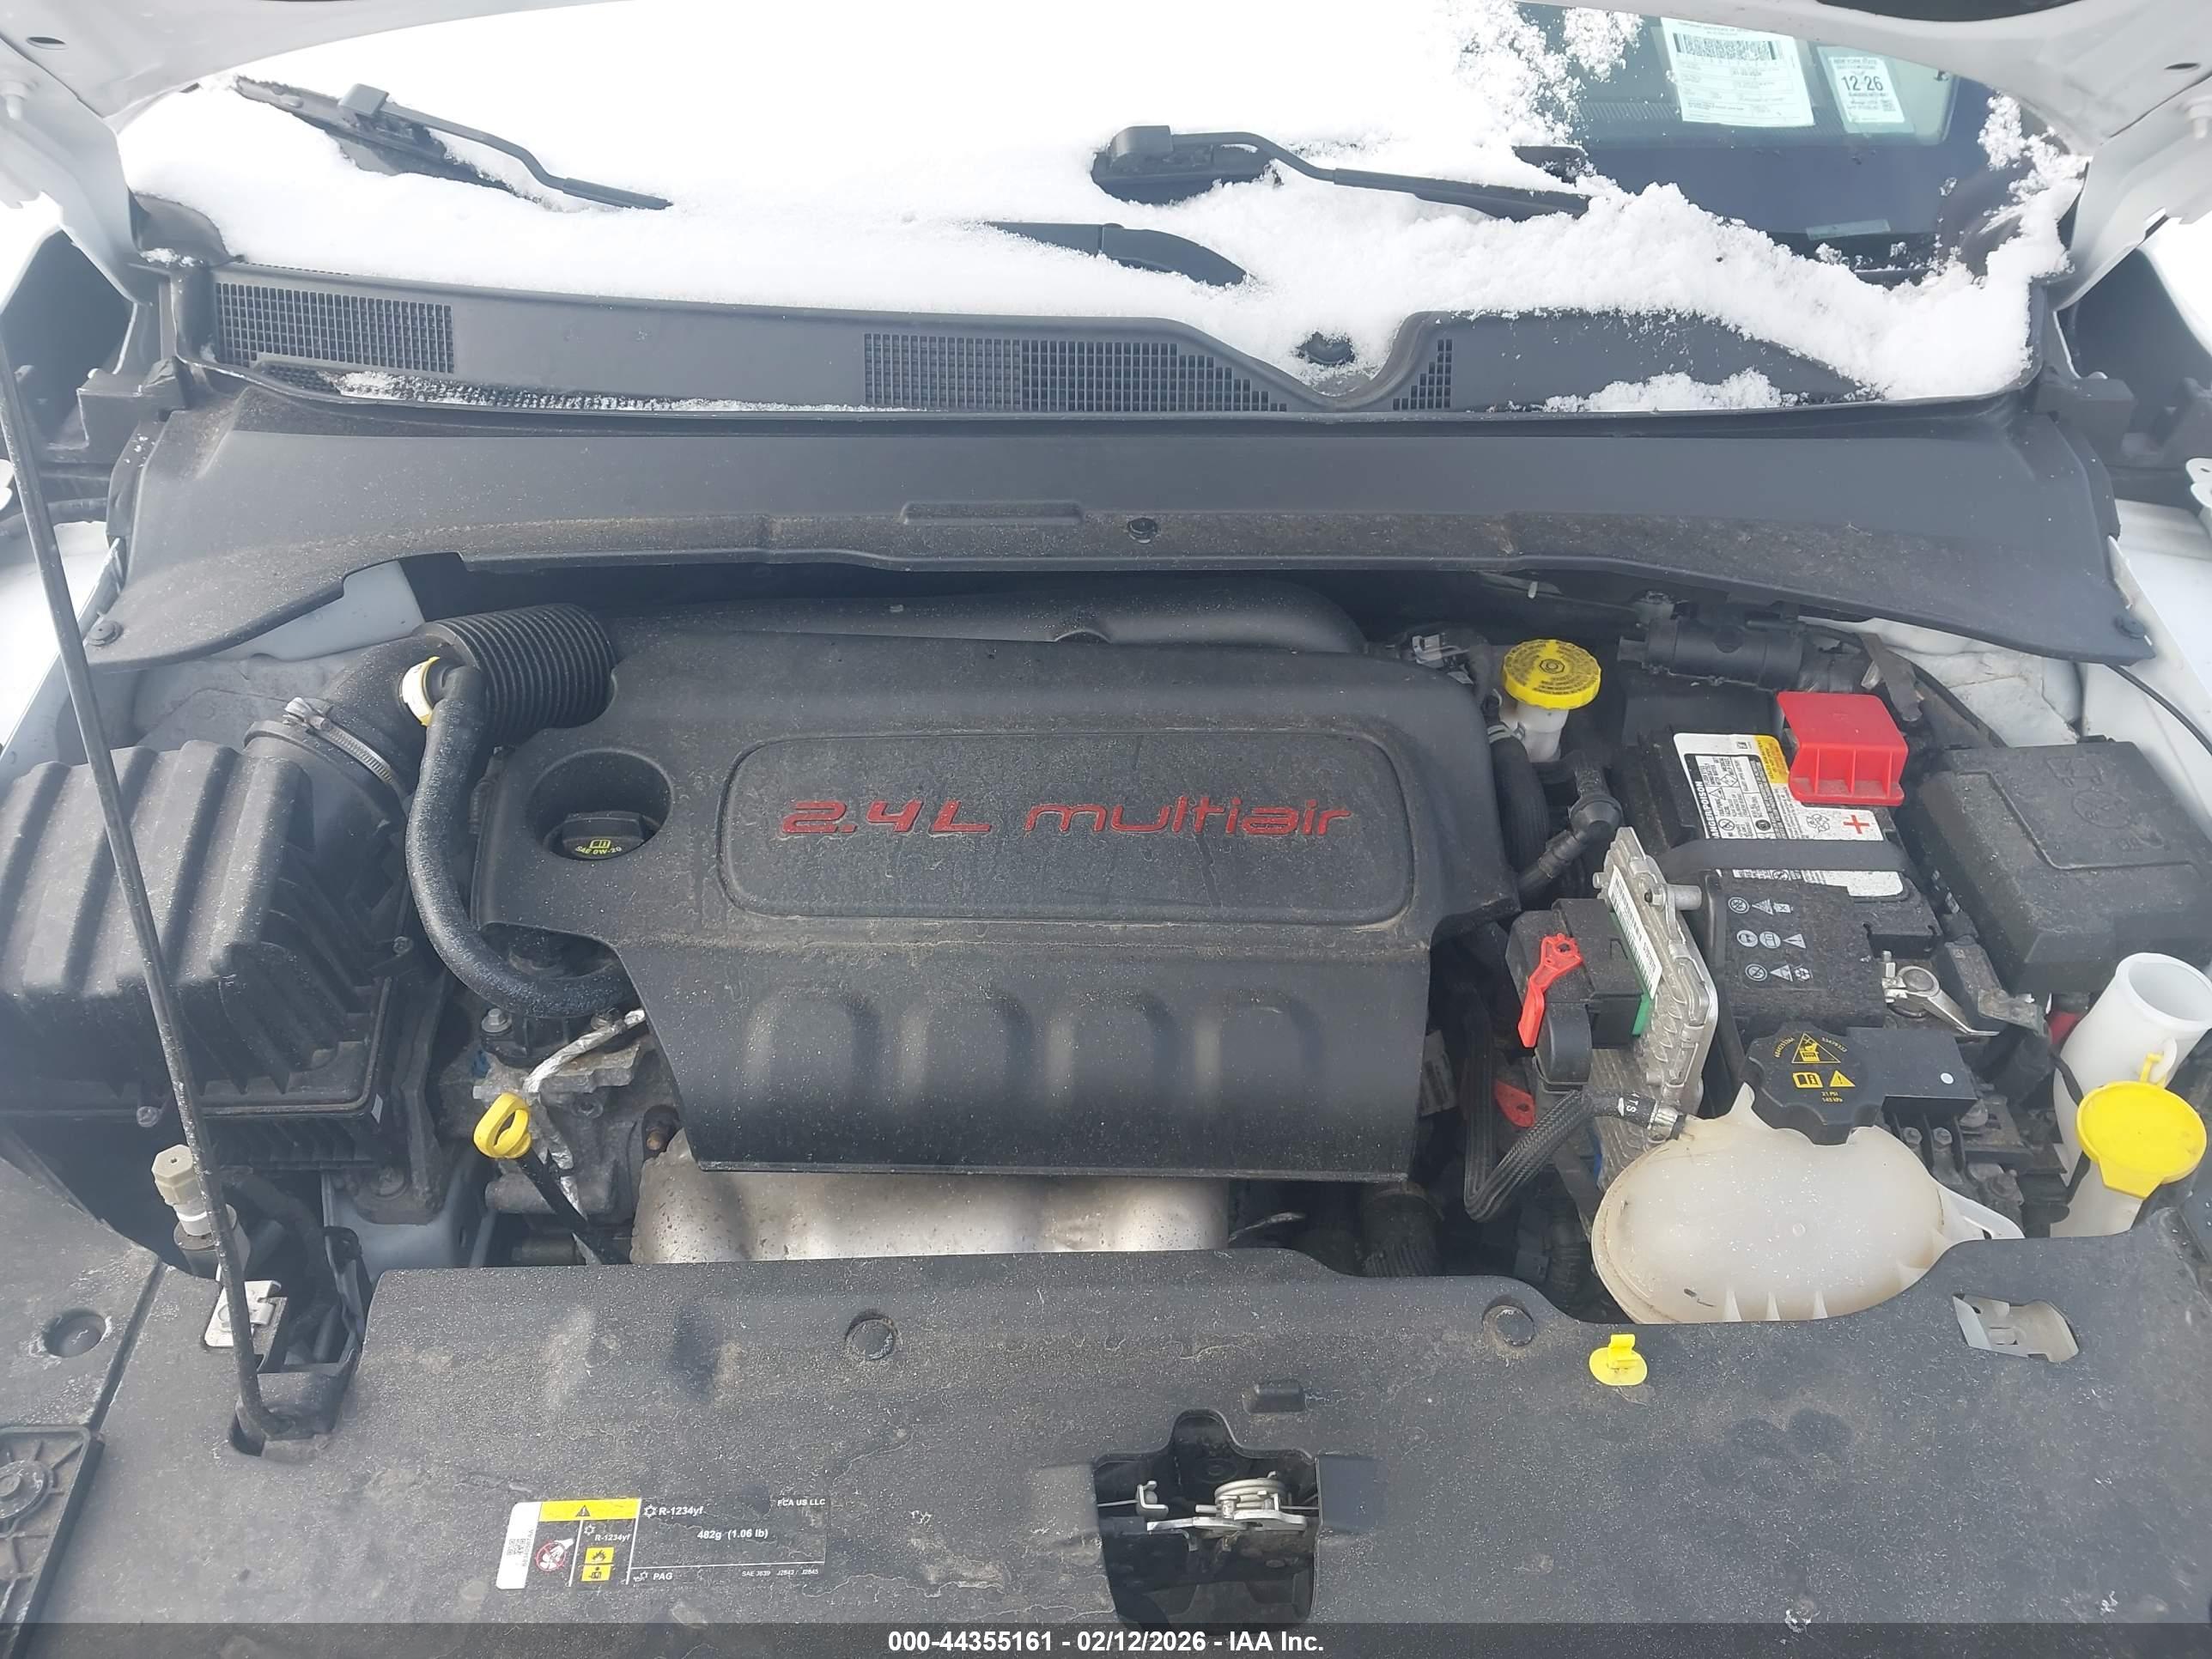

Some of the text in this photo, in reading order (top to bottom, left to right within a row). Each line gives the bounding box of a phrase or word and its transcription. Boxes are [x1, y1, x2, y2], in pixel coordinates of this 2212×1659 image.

[1841, 76, 1883, 91] 12 26
[780, 795, 1352, 836] 2.4L multiair
[1694, 781, 1720, 839] ANGER/POISON
[777, 1498, 794, 1507] FCA
[659, 1506, 703, 1518] R-1234yf
[594, 1534, 632, 1543] R-1234yf
[697, 1528, 769, 1540] 482g (1.06 lb)
[653, 1572, 673, 1581] PAG
